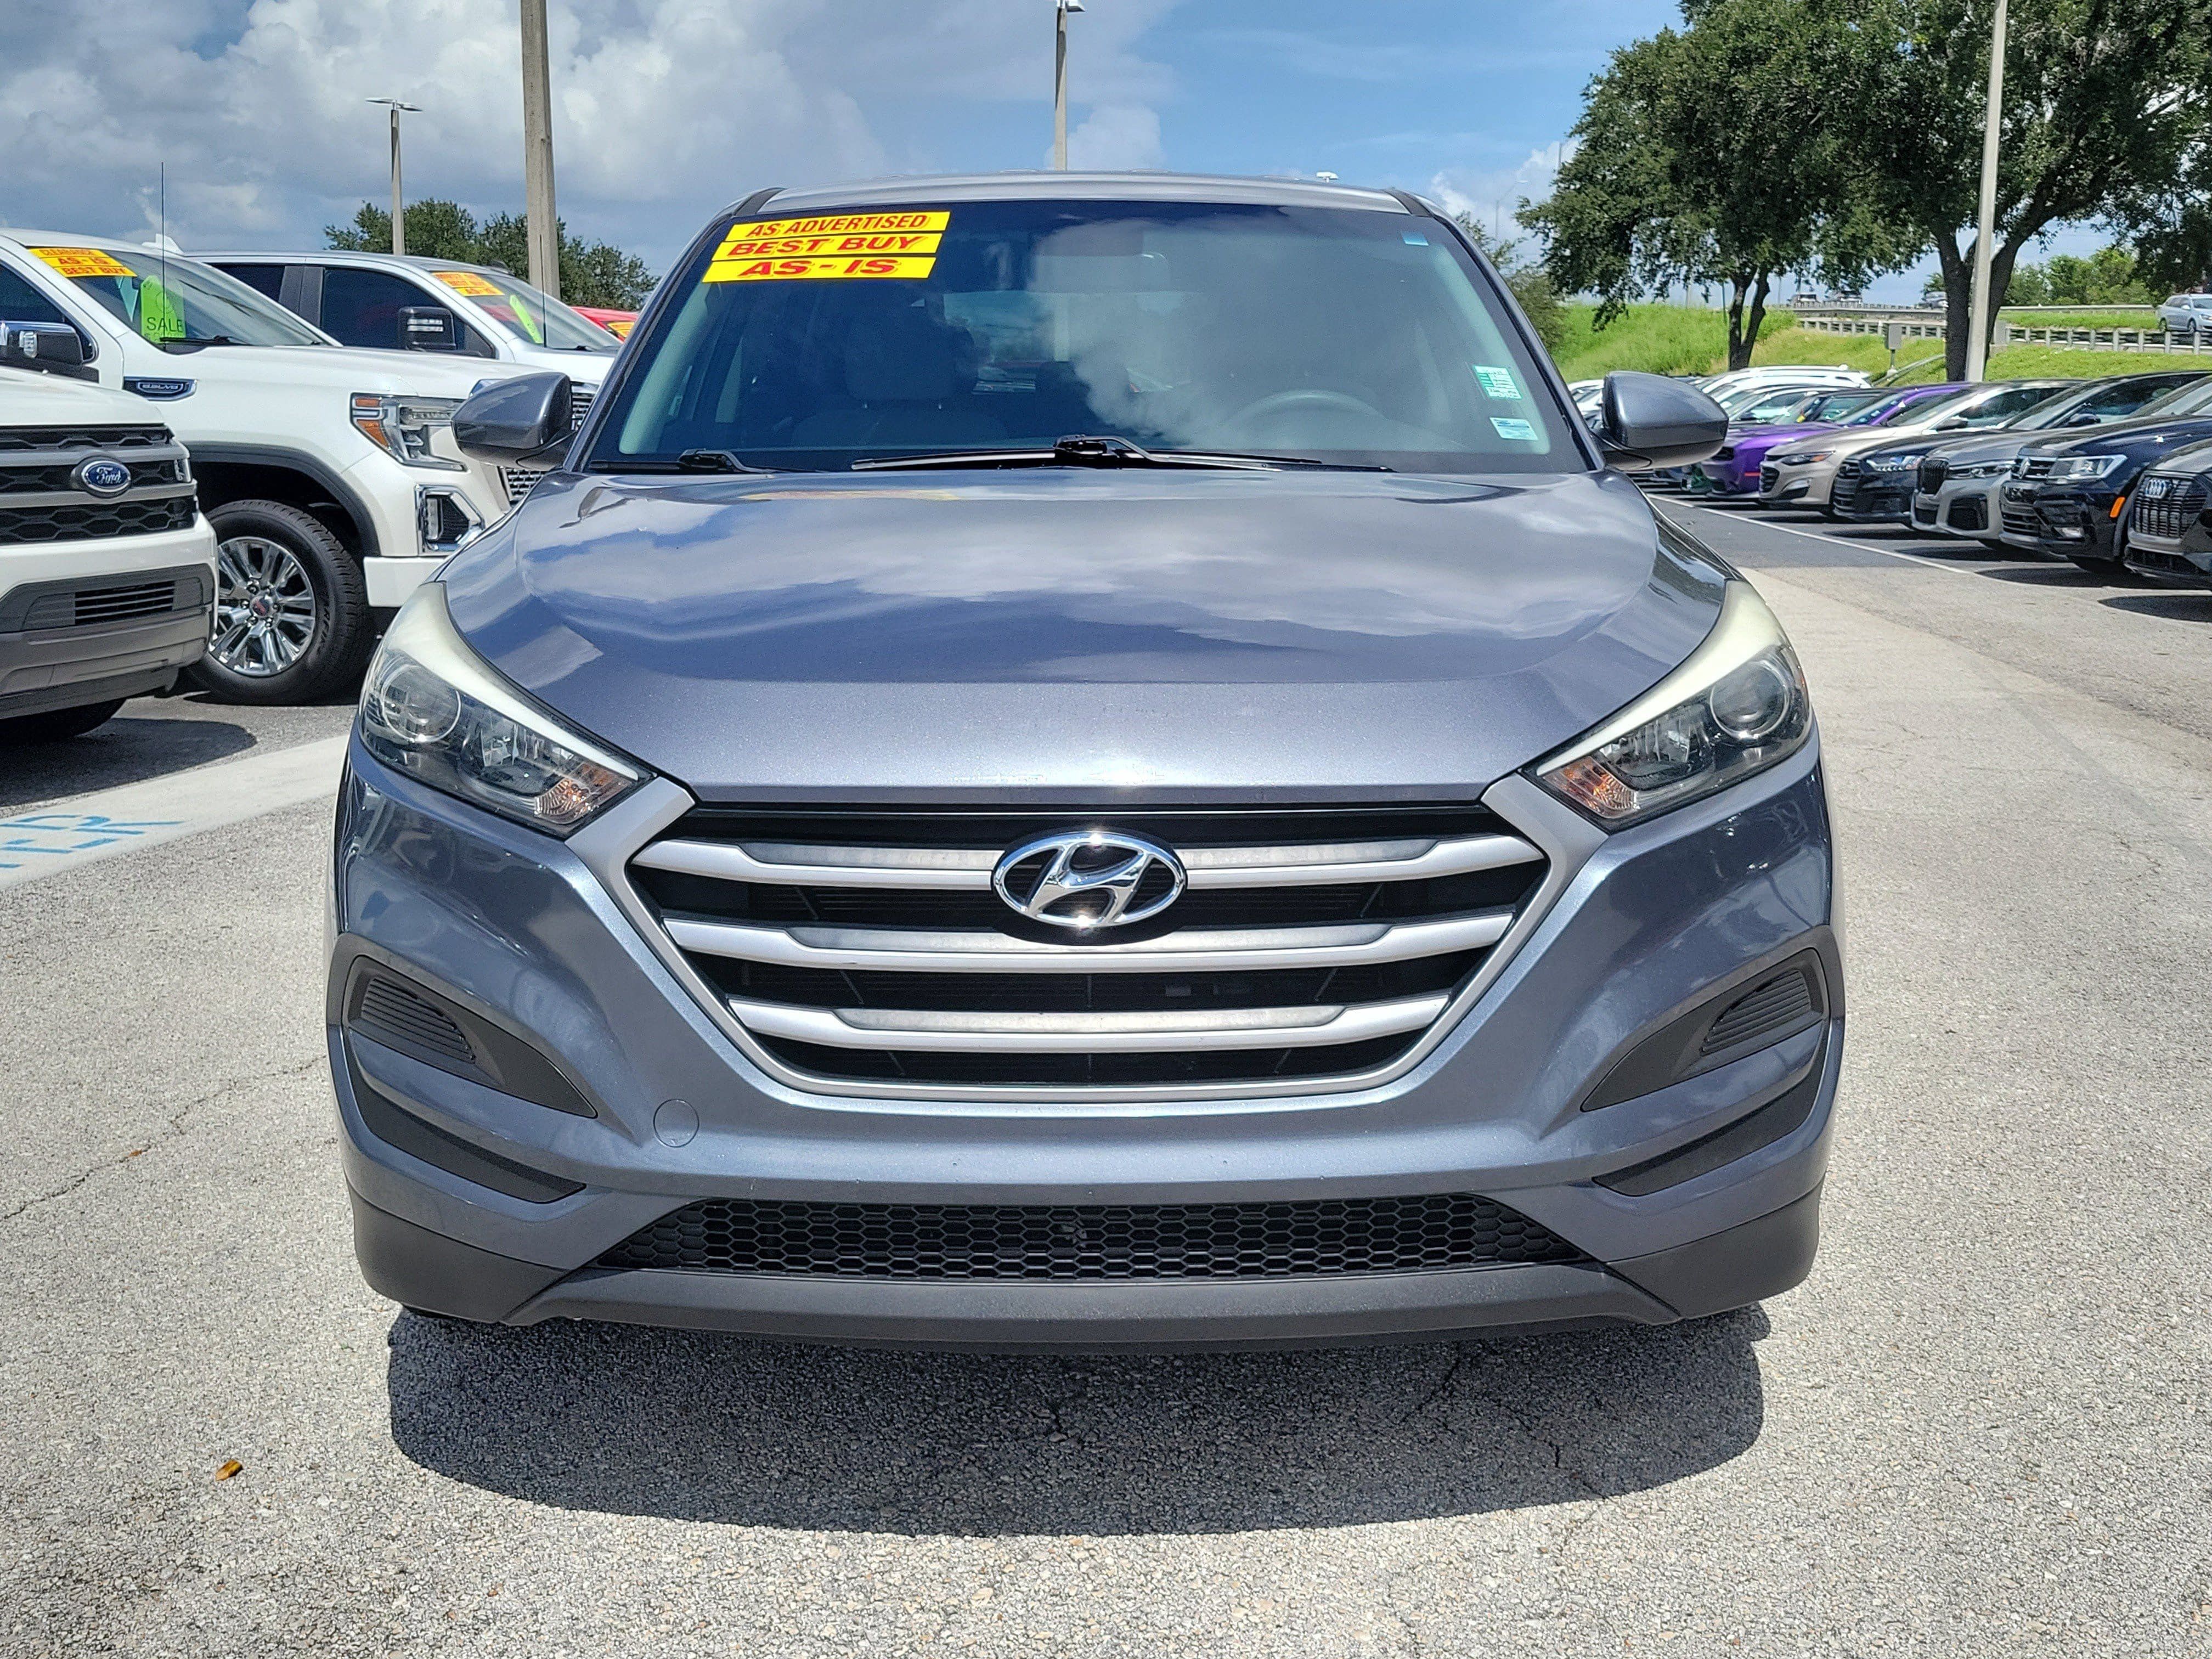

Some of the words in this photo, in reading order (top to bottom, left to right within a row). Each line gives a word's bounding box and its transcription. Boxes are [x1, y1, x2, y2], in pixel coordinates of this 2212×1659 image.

[745, 223, 782, 238] AS
[783, 215, 931, 235] ADVERTISED
[727, 238, 831, 257] BEST
[837, 236, 928, 252] BUY
[146, 317, 183, 332] SALE
[96, 466, 122, 484] Ford
